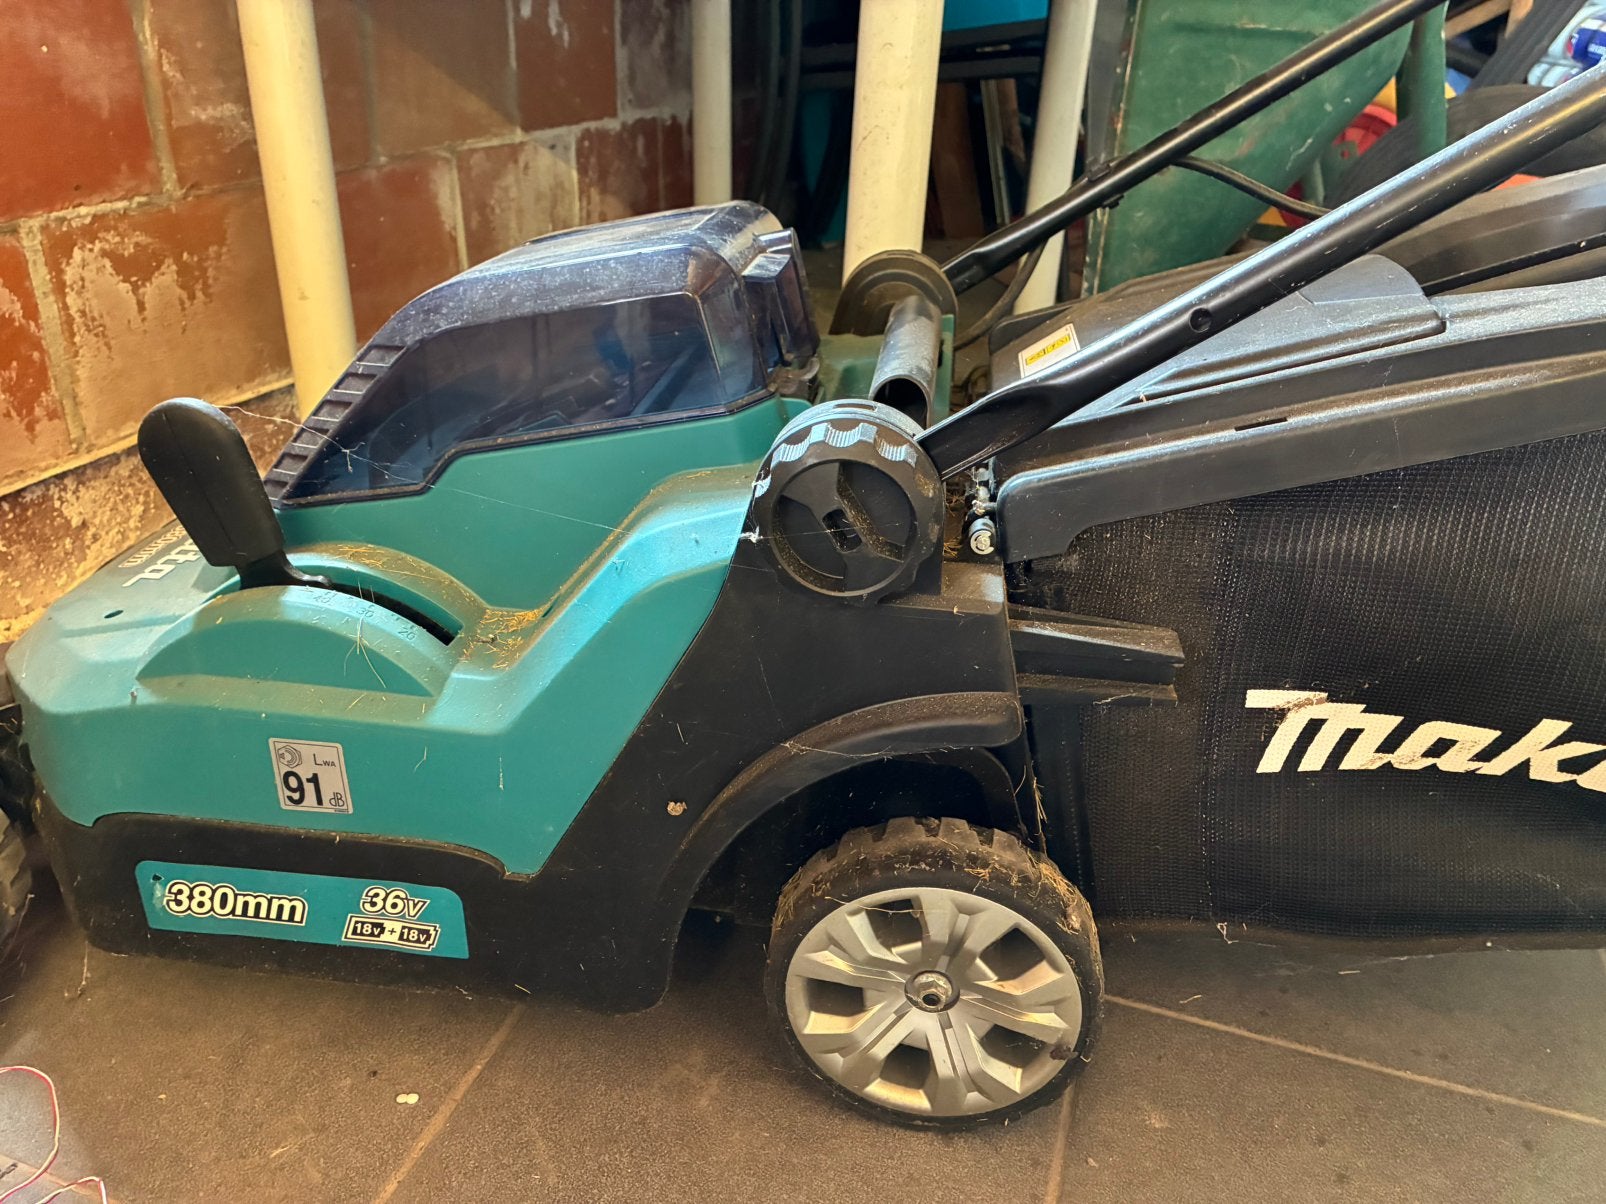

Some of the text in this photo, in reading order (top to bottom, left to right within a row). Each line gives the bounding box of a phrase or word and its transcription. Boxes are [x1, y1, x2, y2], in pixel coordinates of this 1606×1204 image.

[282, 770, 346, 808] 91 dB
[165, 881, 306, 925] 380mm
